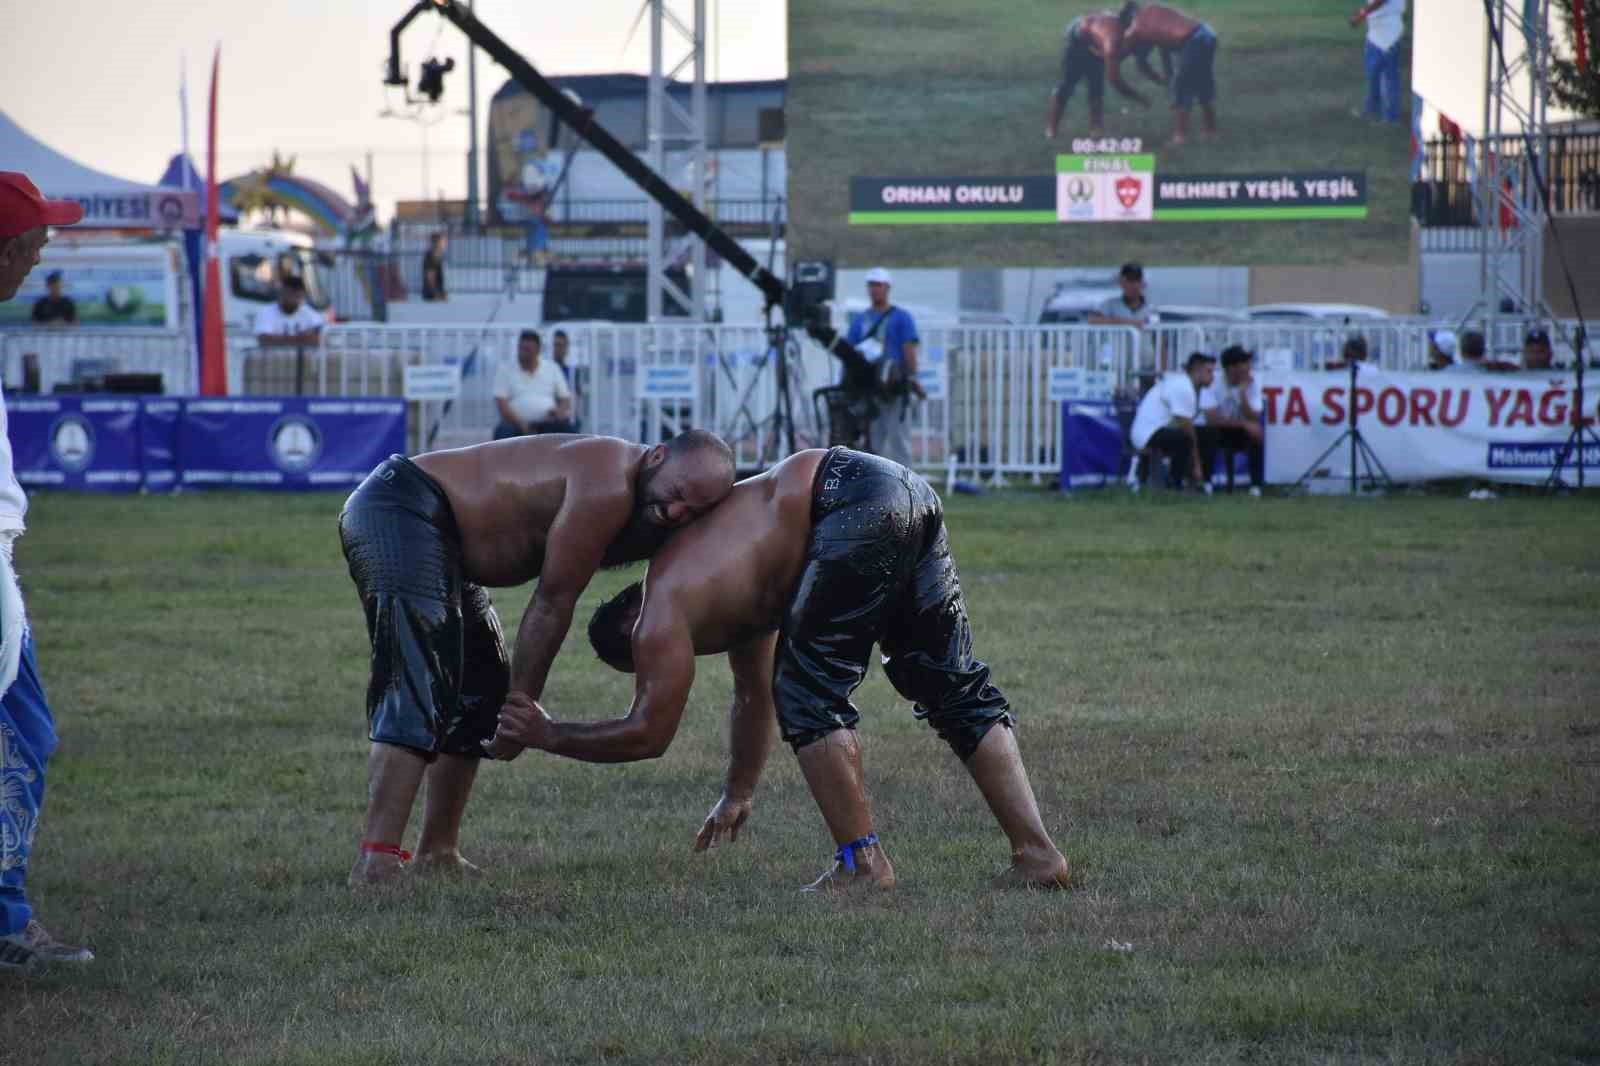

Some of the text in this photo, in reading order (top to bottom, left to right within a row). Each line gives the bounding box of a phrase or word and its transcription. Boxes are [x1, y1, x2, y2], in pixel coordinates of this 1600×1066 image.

[1072, 138, 1142, 153] 00:42:02
[1083, 159, 1132, 173] FINAL
[881, 186, 1024, 204] ORHAN OKULU
[1160, 176, 1358, 202] MEHMET YEŞİL YEŞİL
[66, 191, 151, 219] DİYESİ
[1321, 387, 1470, 427] SPORU
[1485, 379, 1597, 427] YAĞL
